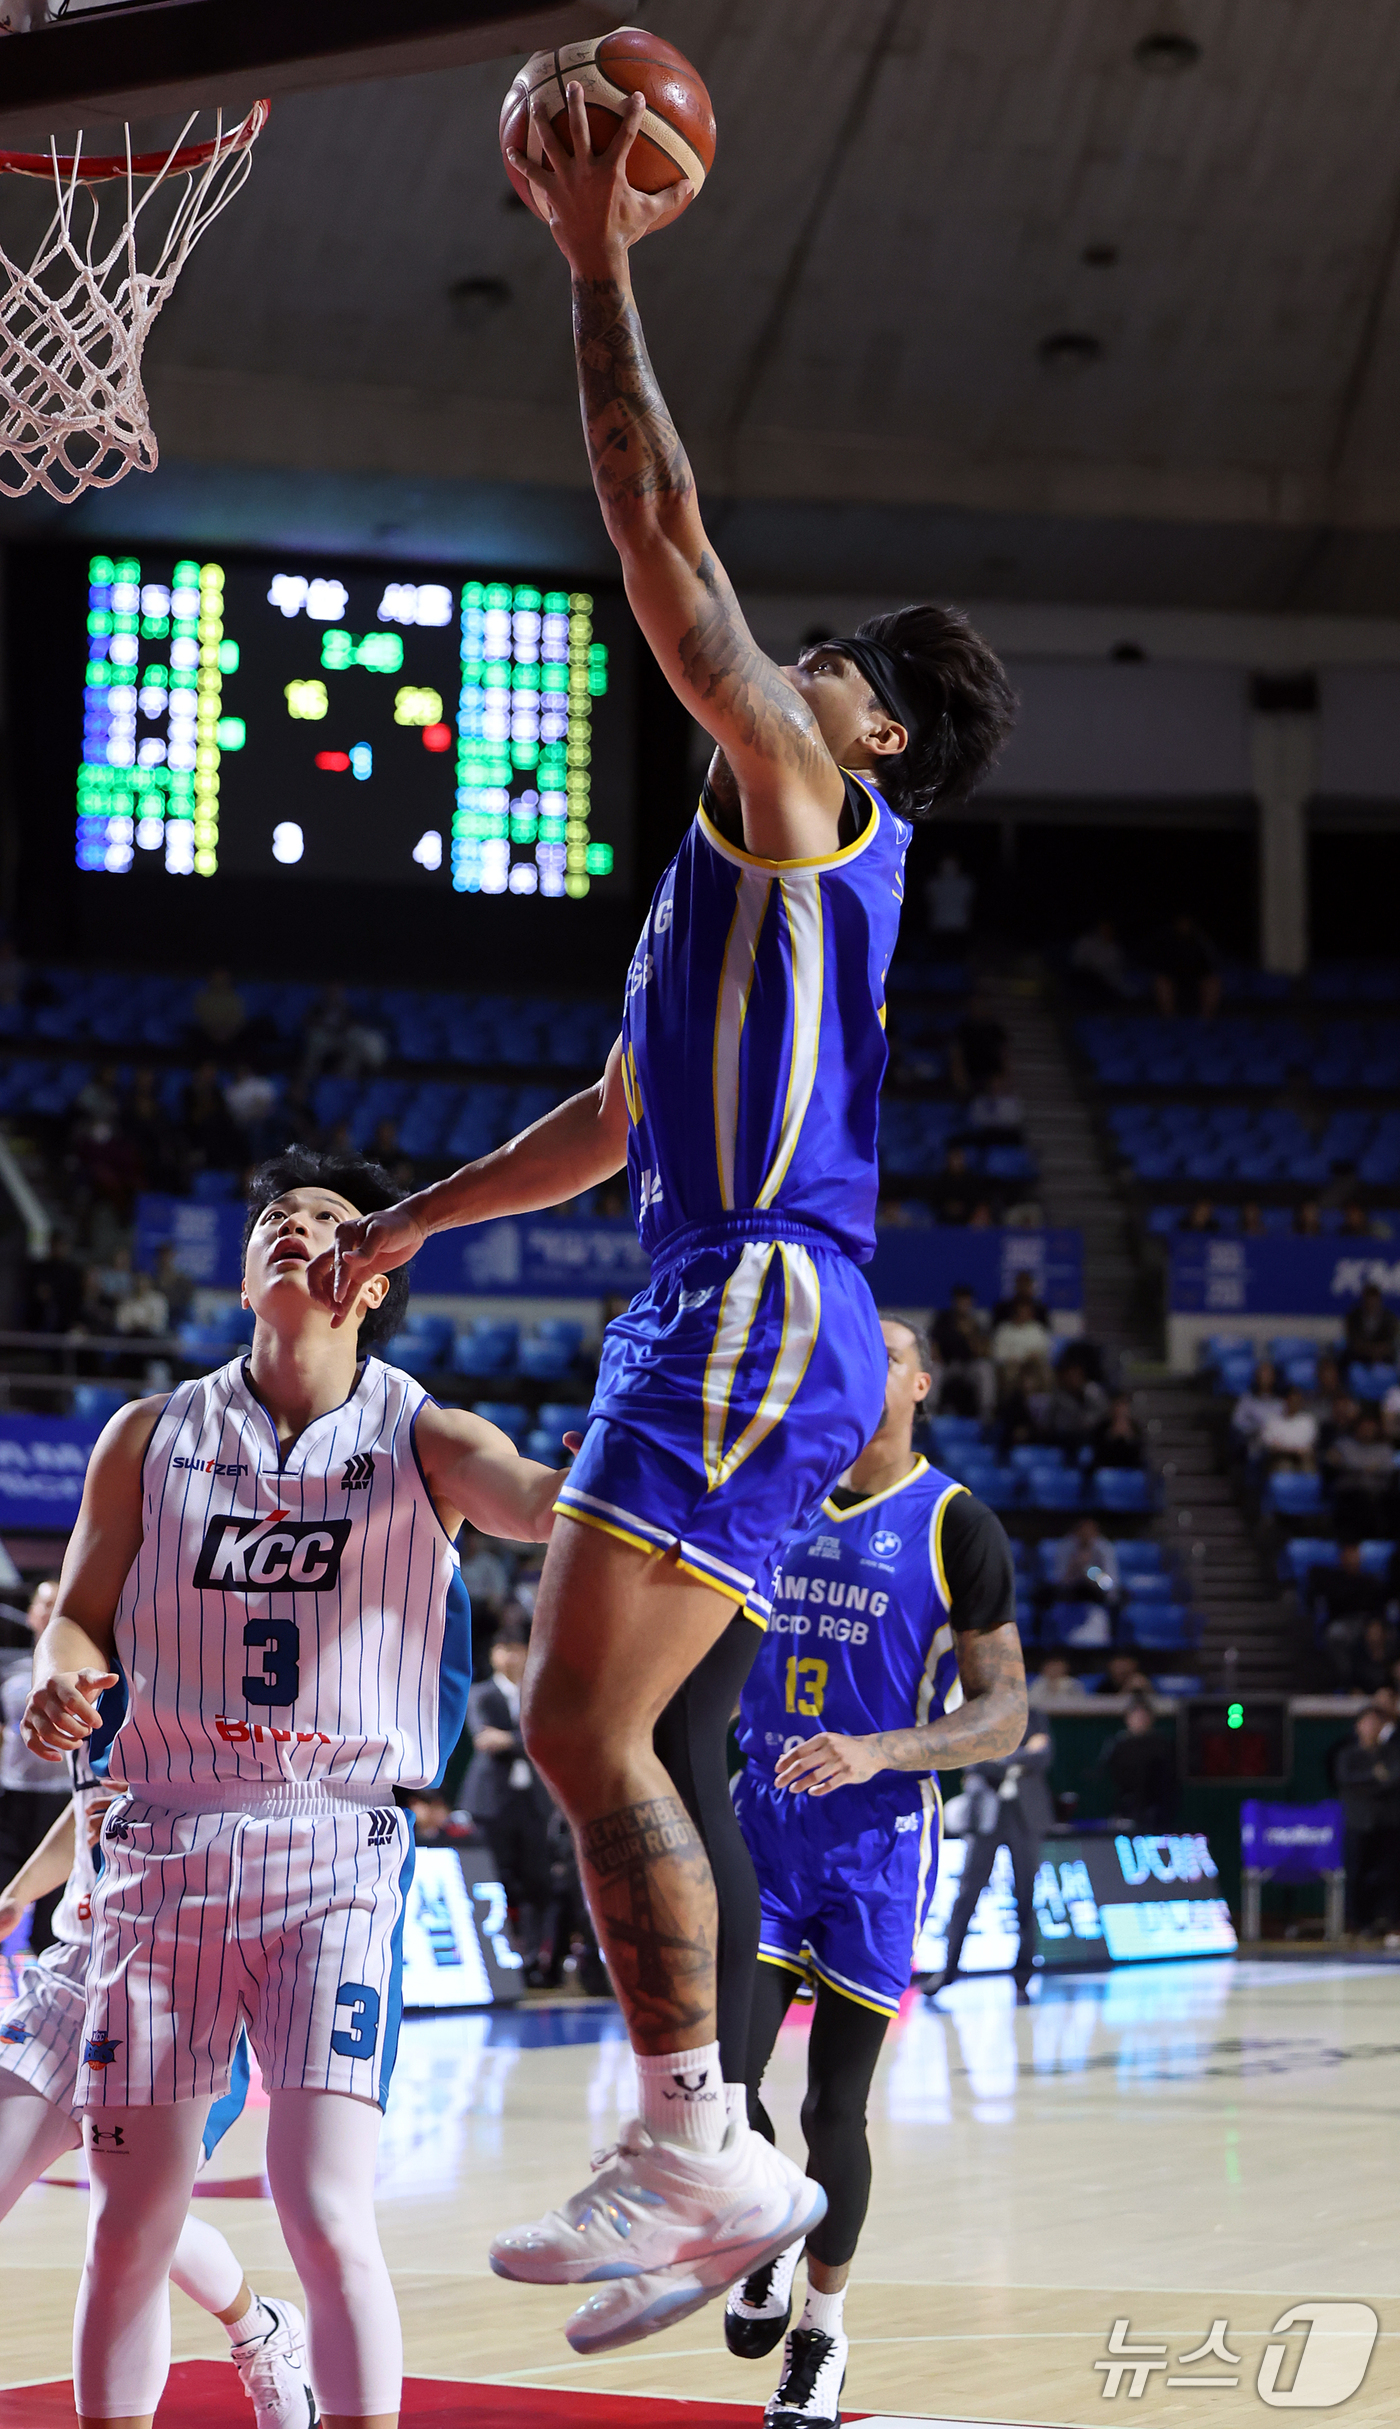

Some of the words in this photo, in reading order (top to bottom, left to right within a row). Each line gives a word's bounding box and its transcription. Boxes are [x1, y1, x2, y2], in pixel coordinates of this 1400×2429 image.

[340, 1480, 371, 1491] PLAY
[208, 1510, 335, 1584] KCC
[767, 1607, 812, 1635] icro
[818, 1614, 870, 1646] RGB
[241, 1618, 300, 1708] 3
[784, 1655, 829, 1717] 13
[367, 1836, 393, 1847] PLAY
[330, 1982, 381, 2061] 3
